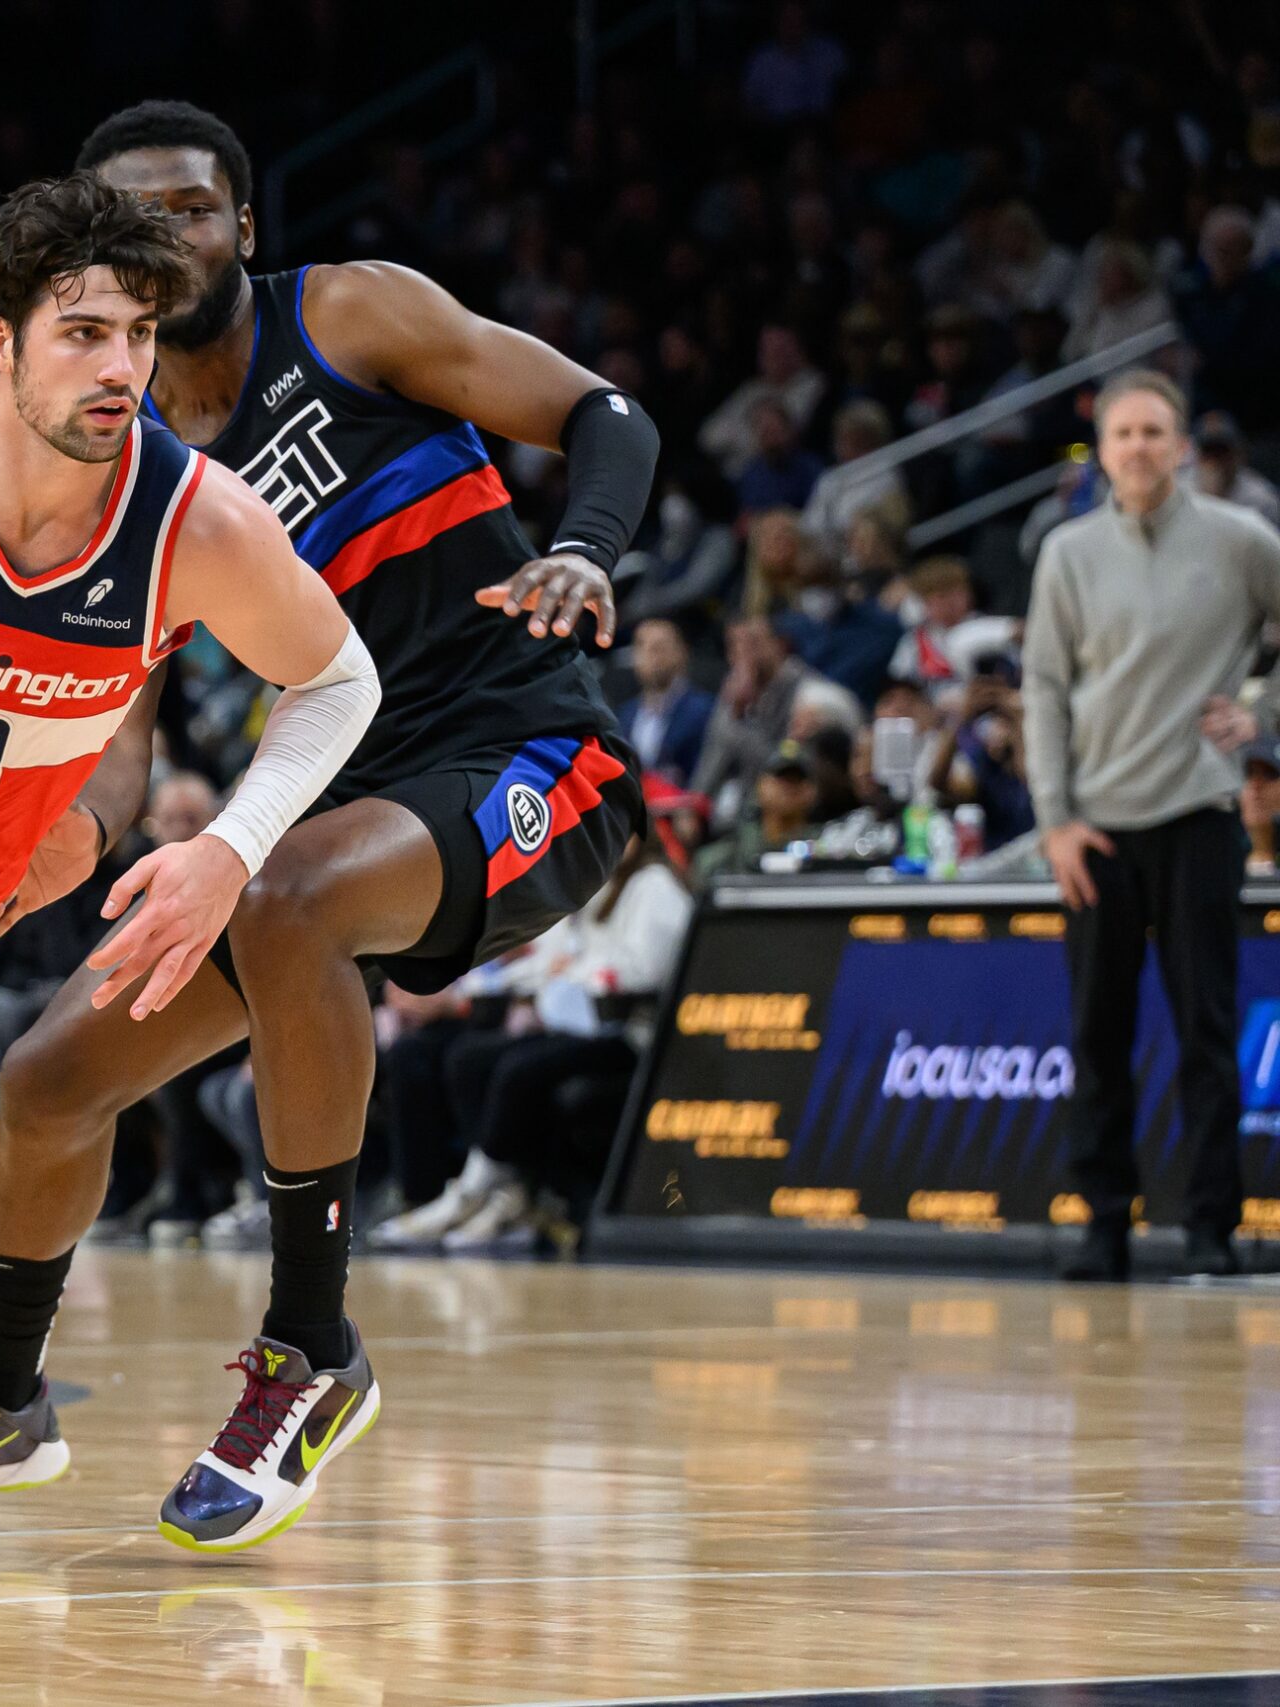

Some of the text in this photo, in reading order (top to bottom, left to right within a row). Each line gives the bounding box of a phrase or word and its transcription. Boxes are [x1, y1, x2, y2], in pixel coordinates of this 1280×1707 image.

[262, 364, 303, 407] UWM
[62, 612, 131, 629] Robinhood
[515, 791, 541, 840] DET
